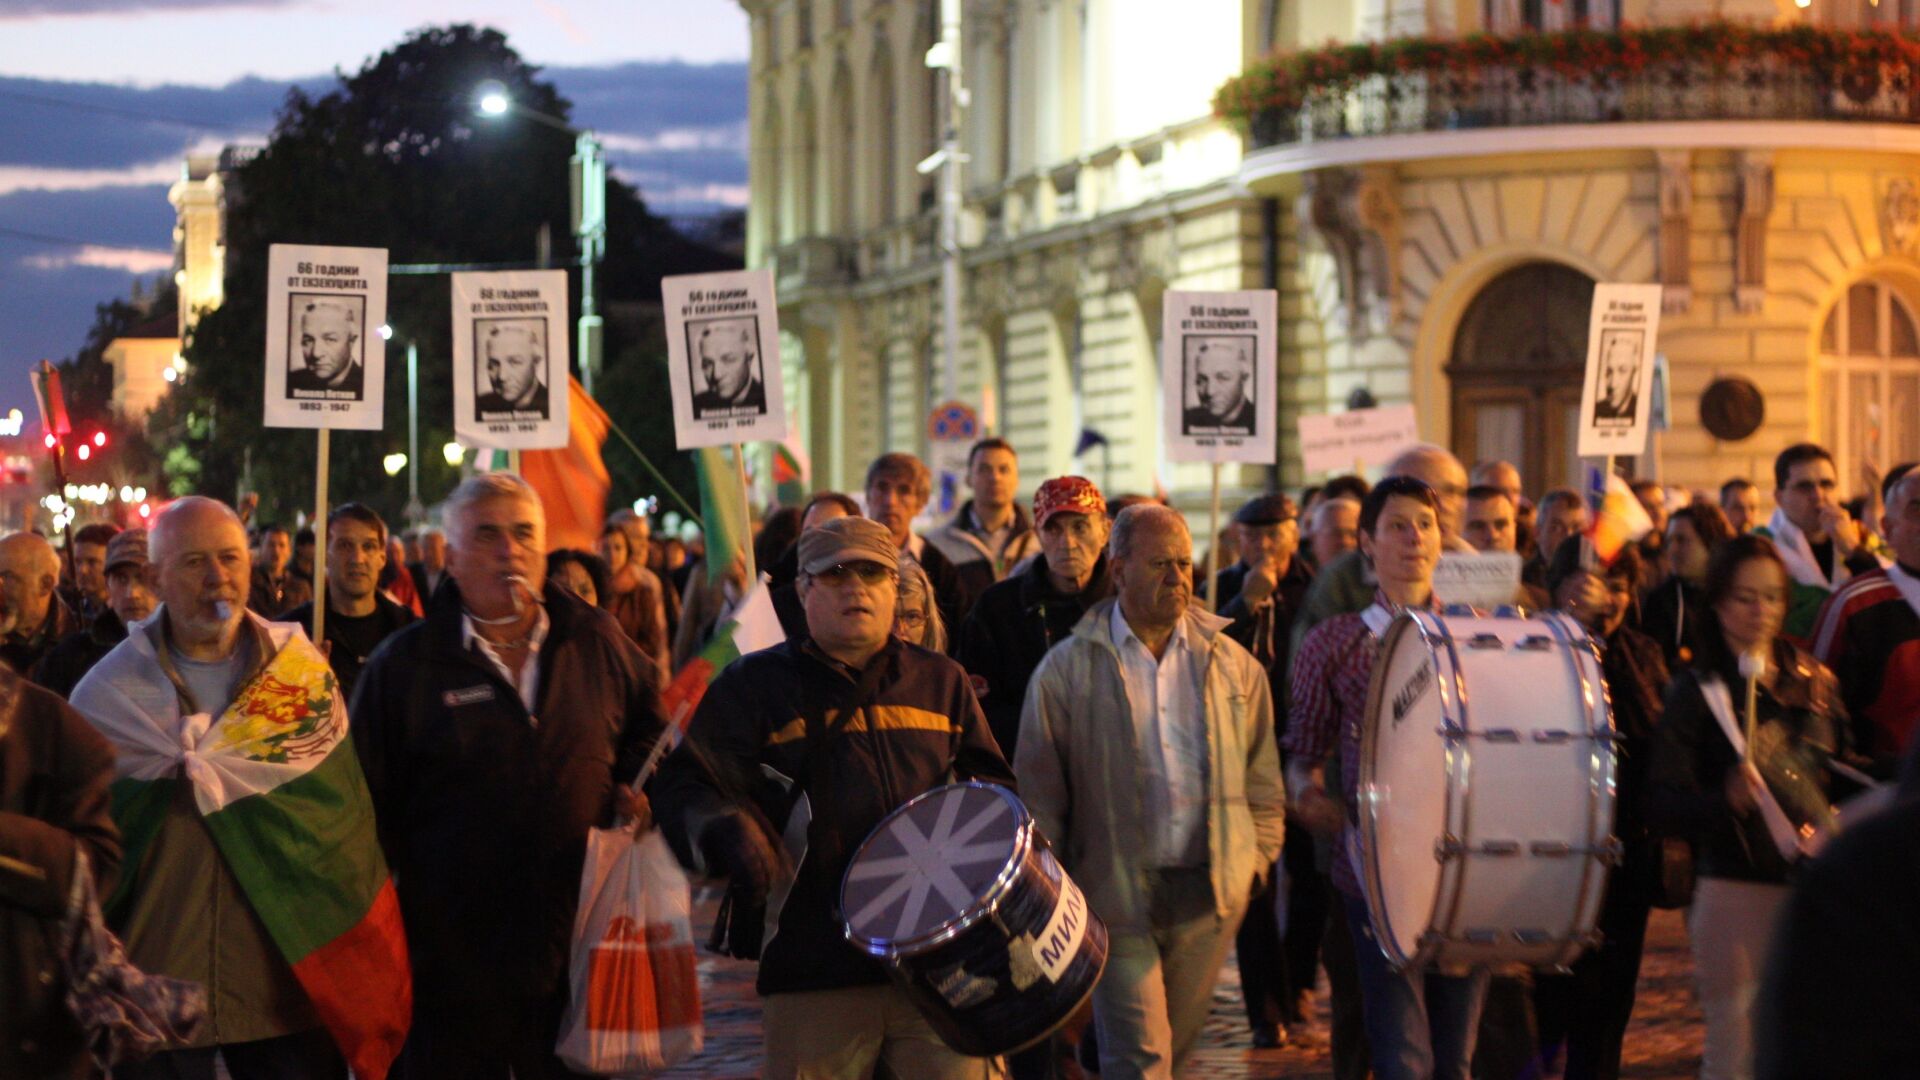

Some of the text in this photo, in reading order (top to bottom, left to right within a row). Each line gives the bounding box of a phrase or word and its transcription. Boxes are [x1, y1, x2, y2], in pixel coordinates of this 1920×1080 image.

[297, 261, 313, 275] 66
[287, 276, 368, 289] ОТ ЕКЗЕКУЦИЯТА
[299, 402, 323, 412] 1893
[329, 403, 351, 412] 1947
